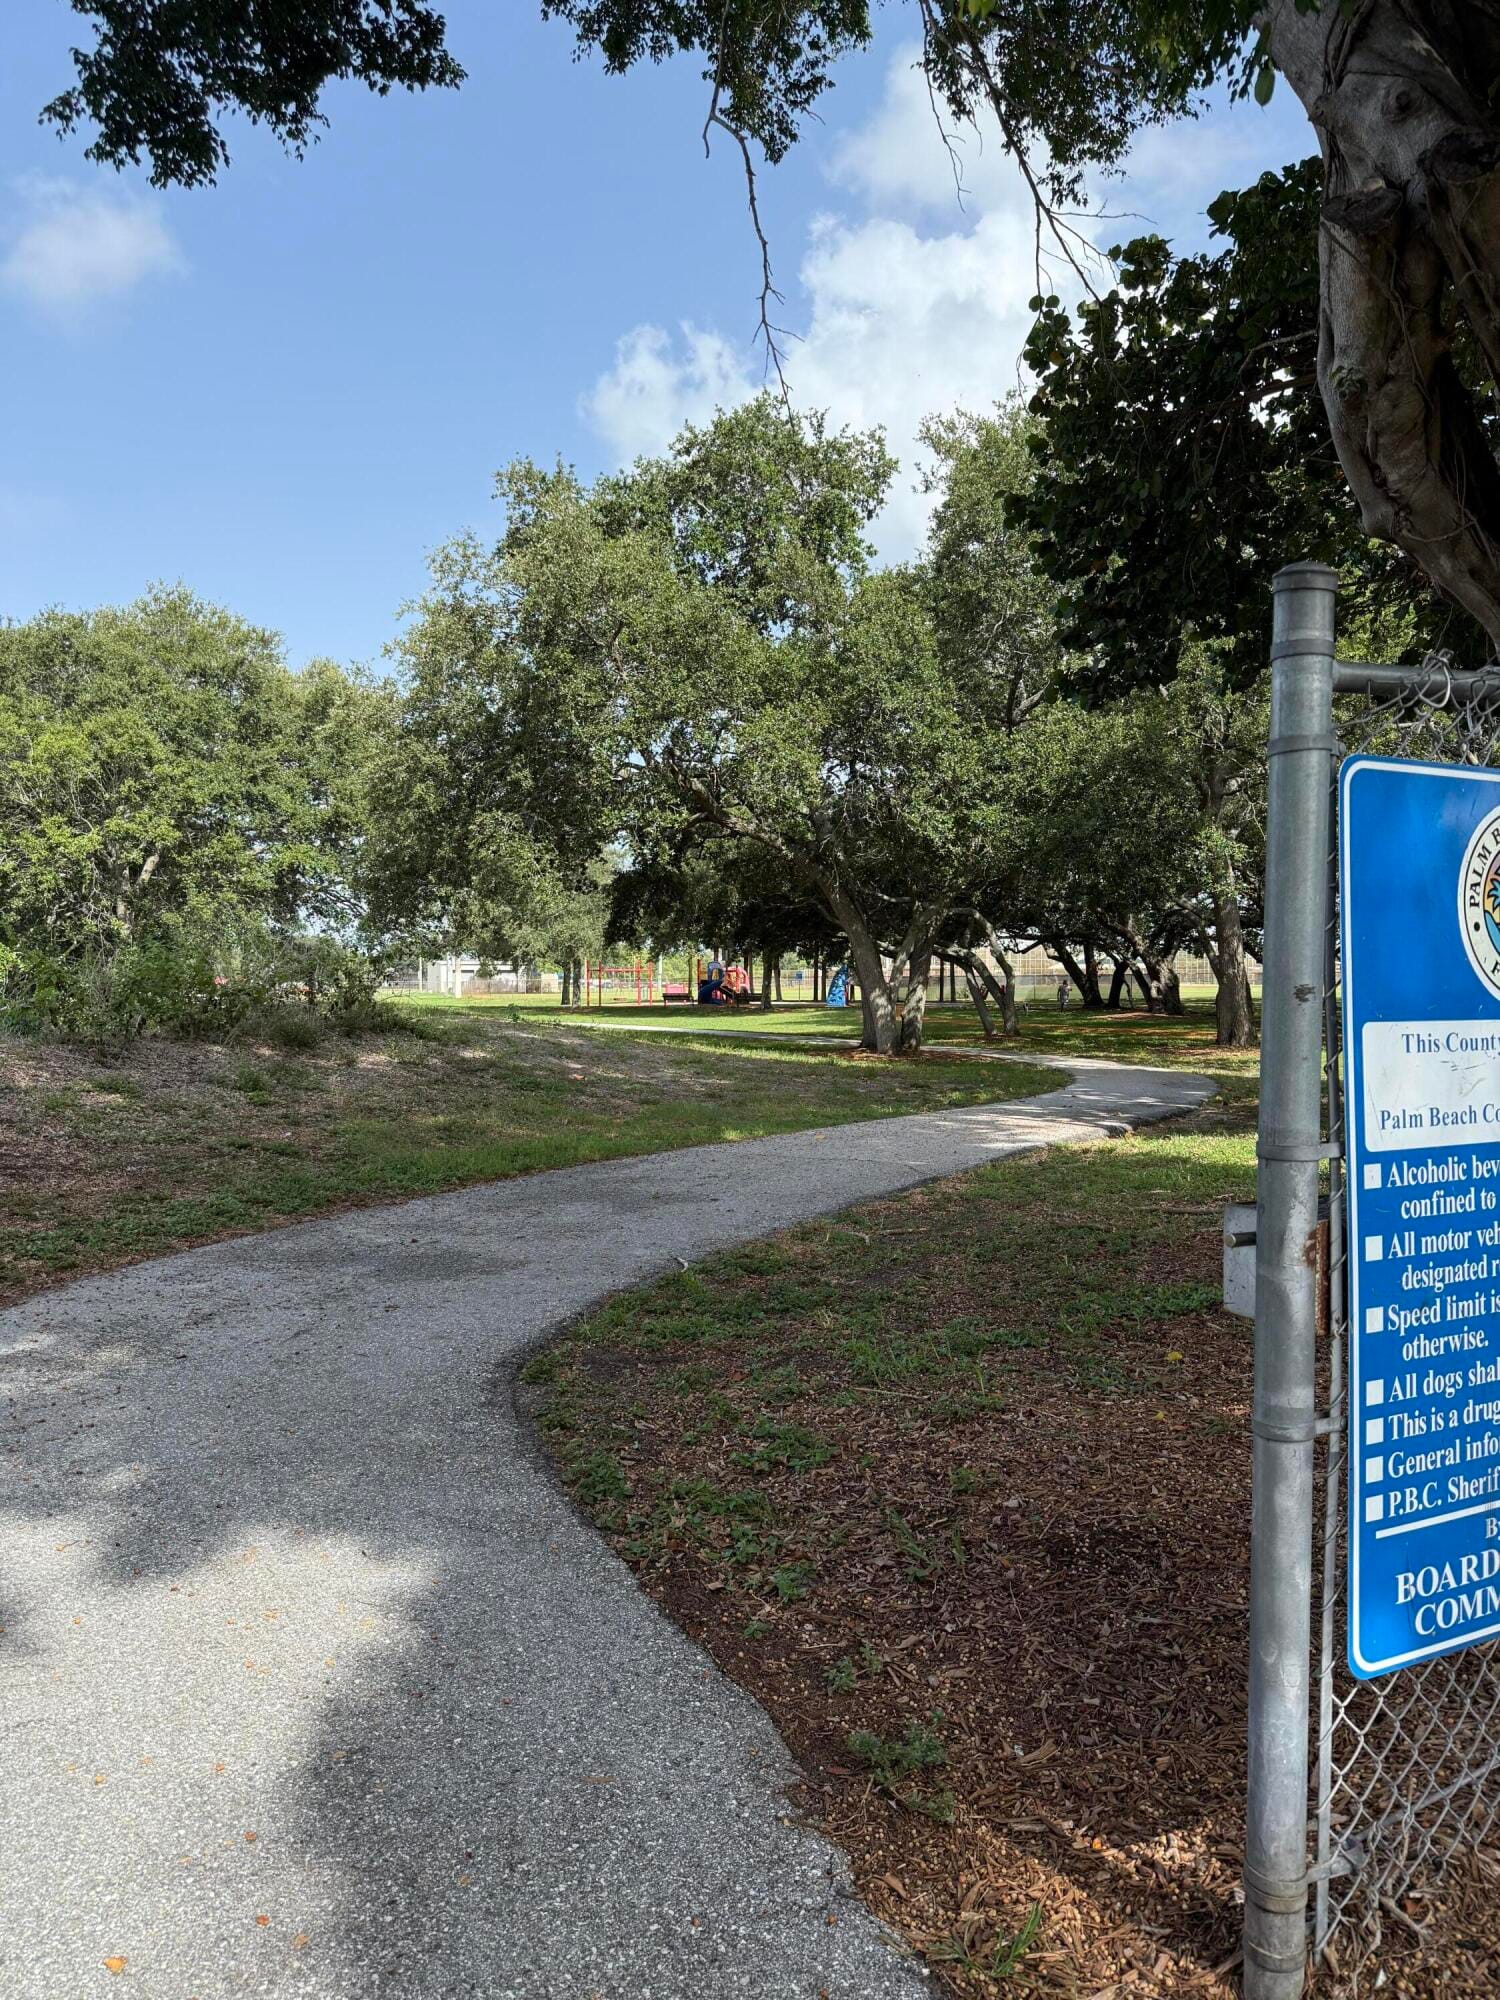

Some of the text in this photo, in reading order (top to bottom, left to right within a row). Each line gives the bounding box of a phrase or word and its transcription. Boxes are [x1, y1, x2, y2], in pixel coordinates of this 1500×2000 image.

[1402, 1033, 1440, 1053] This
[1380, 1109, 1423, 1130] Palm
[1429, 1105, 1477, 1127] Beach
[1387, 1156, 1467, 1187] Alcoholic
[1401, 1187, 1497, 1219] confined to
[1387, 1231, 1416, 1259] All
[1421, 1228, 1472, 1255] motor
[1402, 1254, 1488, 1293] designated
[1388, 1298, 1441, 1336] Speed
[1446, 1292, 1486, 1321] limit
[1402, 1325, 1489, 1361] otherwise.
[1388, 1373, 1417, 1403] All
[1423, 1370, 1463, 1398] dogs
[1388, 1410, 1427, 1440] This
[1431, 1406, 1444, 1432] is
[1449, 1409, 1459, 1428] a
[1388, 1431, 1500, 1479] General info
[1388, 1481, 1442, 1517] P.B.C.
[1395, 1548, 1500, 1605] BOARD
